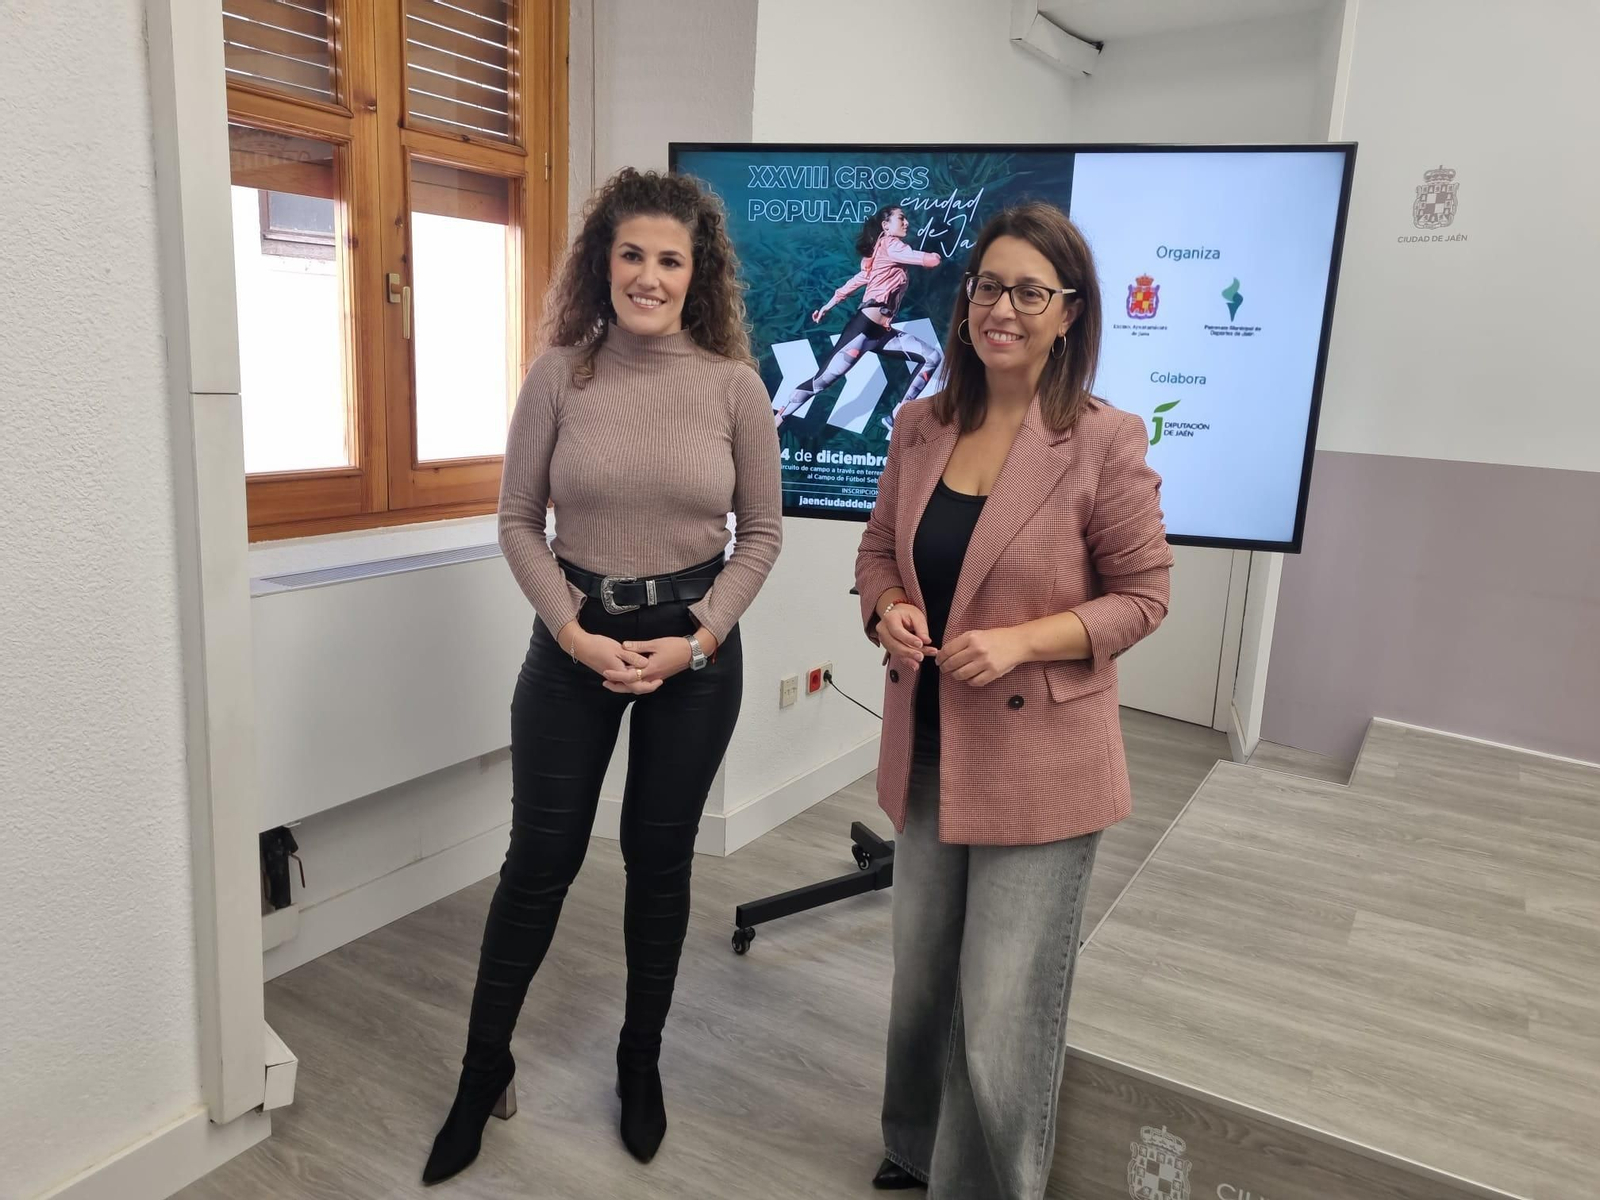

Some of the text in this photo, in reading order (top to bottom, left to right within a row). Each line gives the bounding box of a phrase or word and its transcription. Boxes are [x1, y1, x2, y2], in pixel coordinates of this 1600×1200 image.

[748, 165, 929, 190] XXVIII CROSS
[748, 199, 877, 223] POPULAR
[900, 188, 984, 220] ciudad
[917, 214, 977, 258] de Ja
[1397, 235, 1430, 243] CIUDAD
[1444, 233, 1468, 242] JAÉN
[1156, 245, 1221, 262] Organiza
[1150, 371, 1206, 385] Colabora
[1164, 421, 1210, 431] DIPUTACIÓN
[1175, 429, 1194, 438] JAÉN
[794, 448, 812, 462] de
[845, 475, 865, 483] Fútbol
[866, 476, 879, 484] Seb
